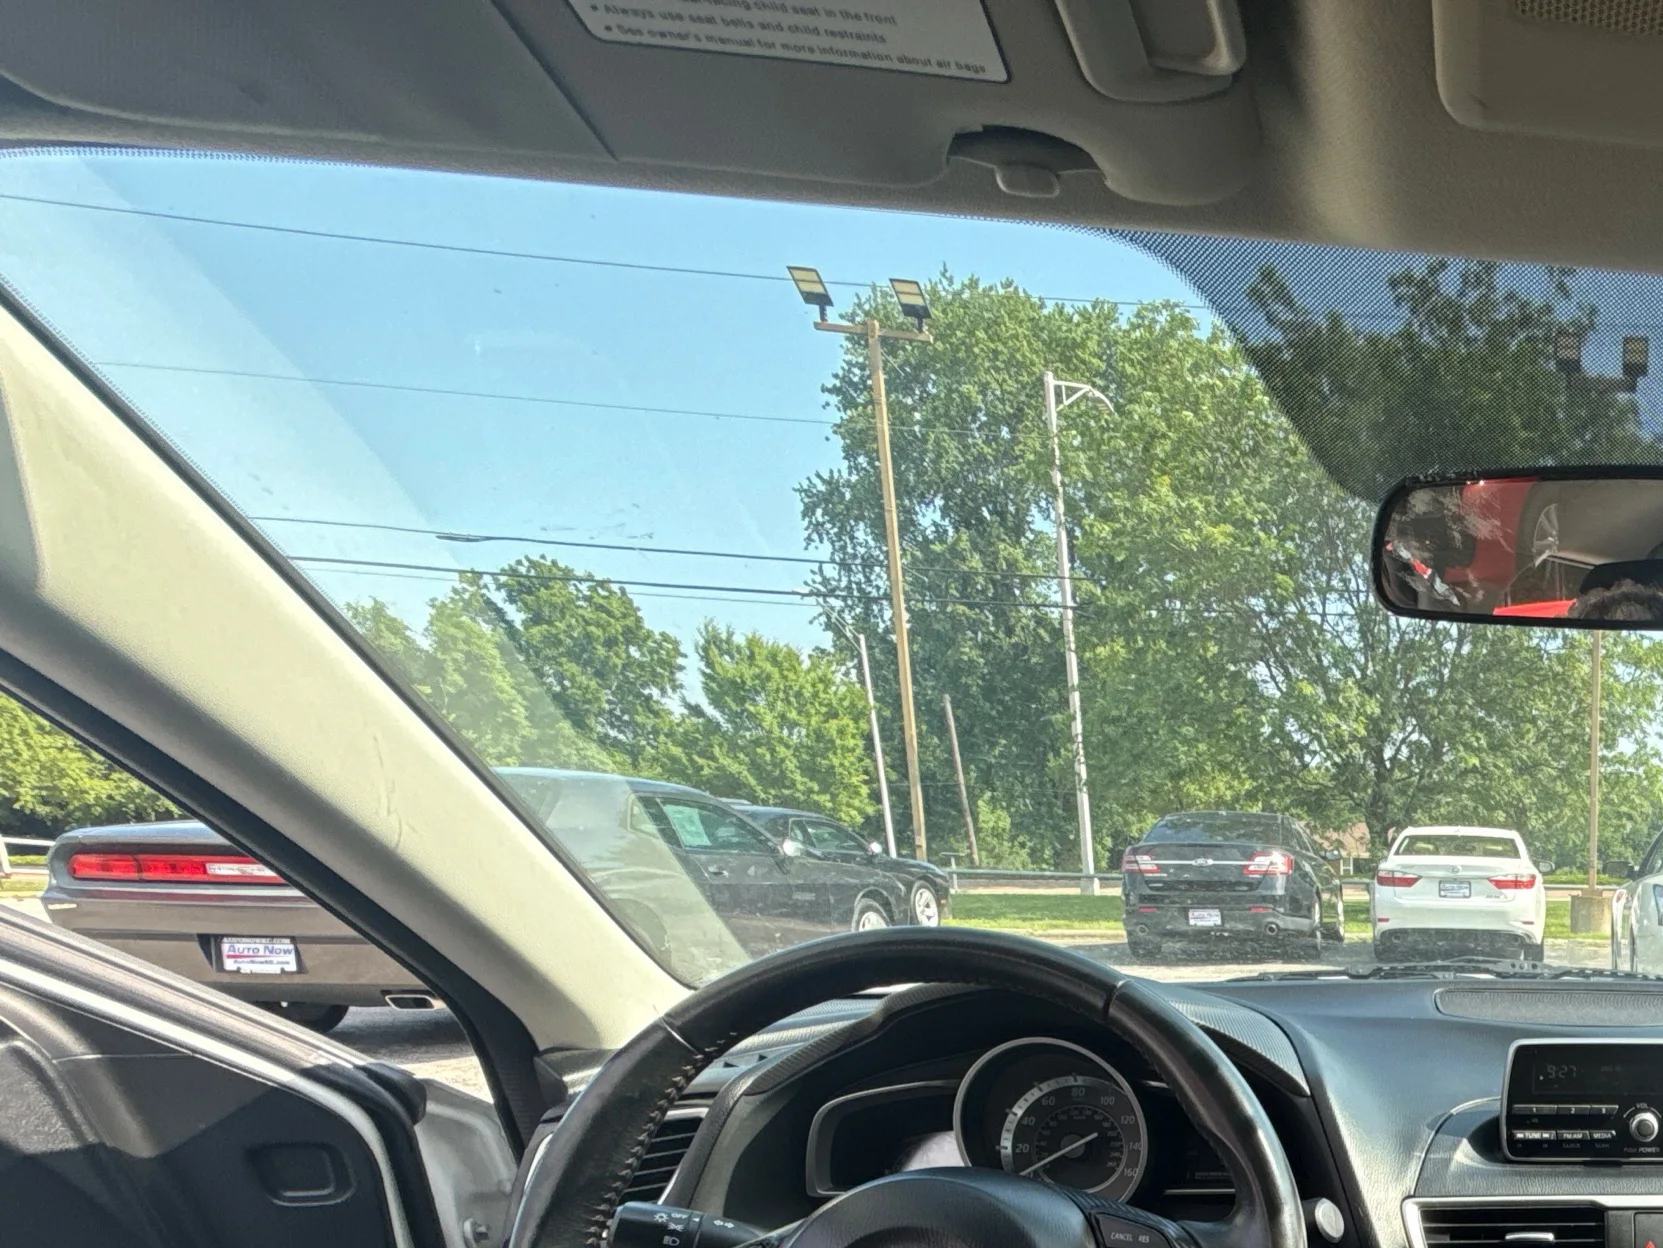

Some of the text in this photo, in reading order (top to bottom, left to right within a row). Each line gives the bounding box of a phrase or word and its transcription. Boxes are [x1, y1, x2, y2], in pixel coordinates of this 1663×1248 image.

[864, 11, 898, 26] front
[1071, 1088, 1086, 1097] 80
[1042, 1096, 1056, 1106] 60
[1100, 1096, 1115, 1106] 100
[1022, 1116, 1036, 1126] 40
[1120, 1115, 1136, 1125] 120
[1016, 1144, 1030, 1153] 20
[1124, 1168, 1138, 1177] 160
[1110, 1232, 1133, 1242] CANCEL
[1138, 1235, 1150, 1244] RES
